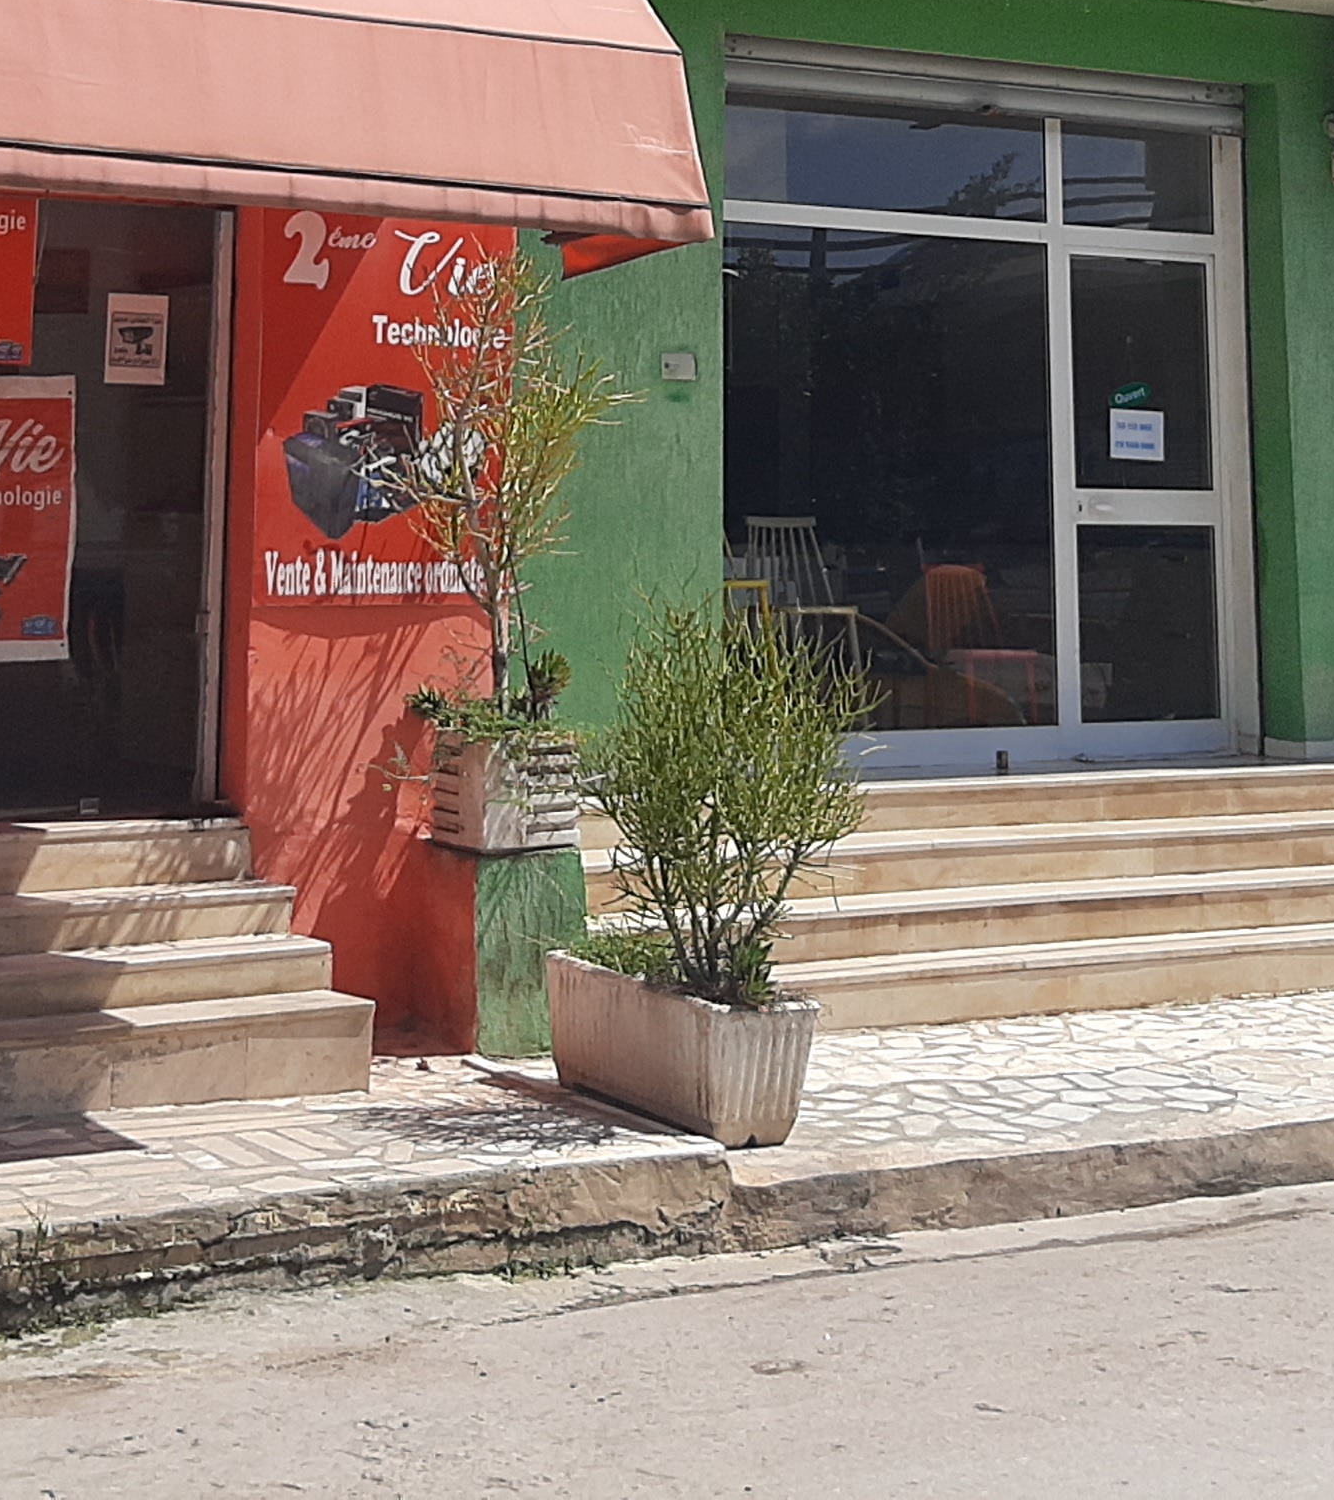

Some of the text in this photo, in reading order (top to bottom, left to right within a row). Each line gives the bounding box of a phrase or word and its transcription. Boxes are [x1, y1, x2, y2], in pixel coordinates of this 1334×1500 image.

[394, 230, 498, 296] Vie
[265, 550, 312, 597] Vente
[314, 548, 327, 596] &
[330, 549, 423, 596] Maintenance
